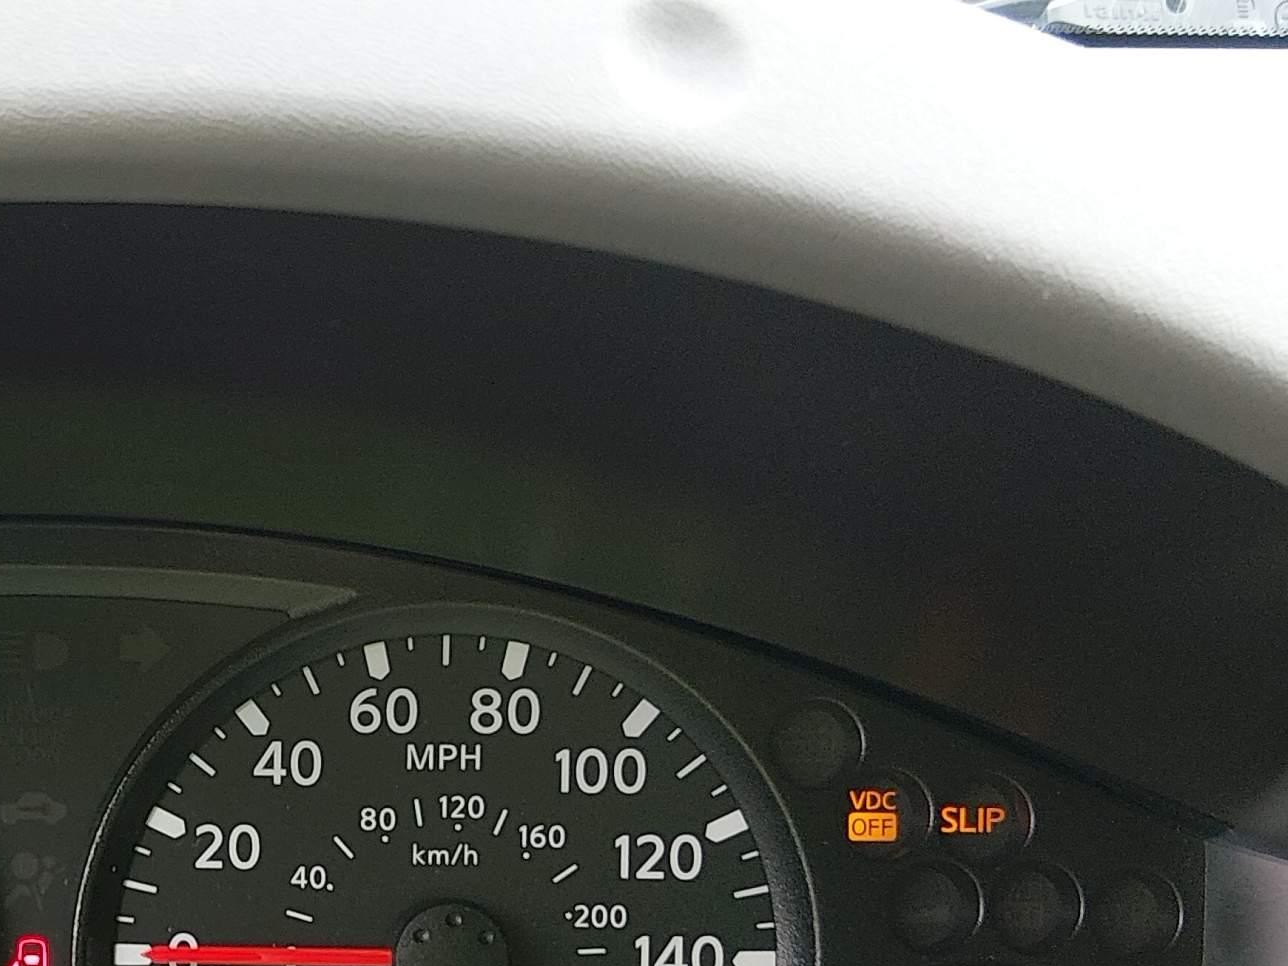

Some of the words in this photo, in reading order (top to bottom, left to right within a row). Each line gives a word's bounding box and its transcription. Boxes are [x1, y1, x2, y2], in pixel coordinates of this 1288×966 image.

[351, 689, 417, 734] 60
[471, 689, 539, 734] 80
[254, 741, 321, 786] 40
[407, 744, 481, 770] MPH
[556, 748, 645, 794] 100
[440, 796, 484, 819] 120
[850, 791, 896, 810] VDC
[360, 808, 396, 831] 80
[852, 818, 893, 836] OFF
[941, 807, 1005, 833] SLIP
[195, 824, 260, 870] 20
[519, 825, 566, 849] 160
[412, 844, 478, 866] km/h
[615, 834, 702, 881] 120
[574, 905, 627, 929] 200
